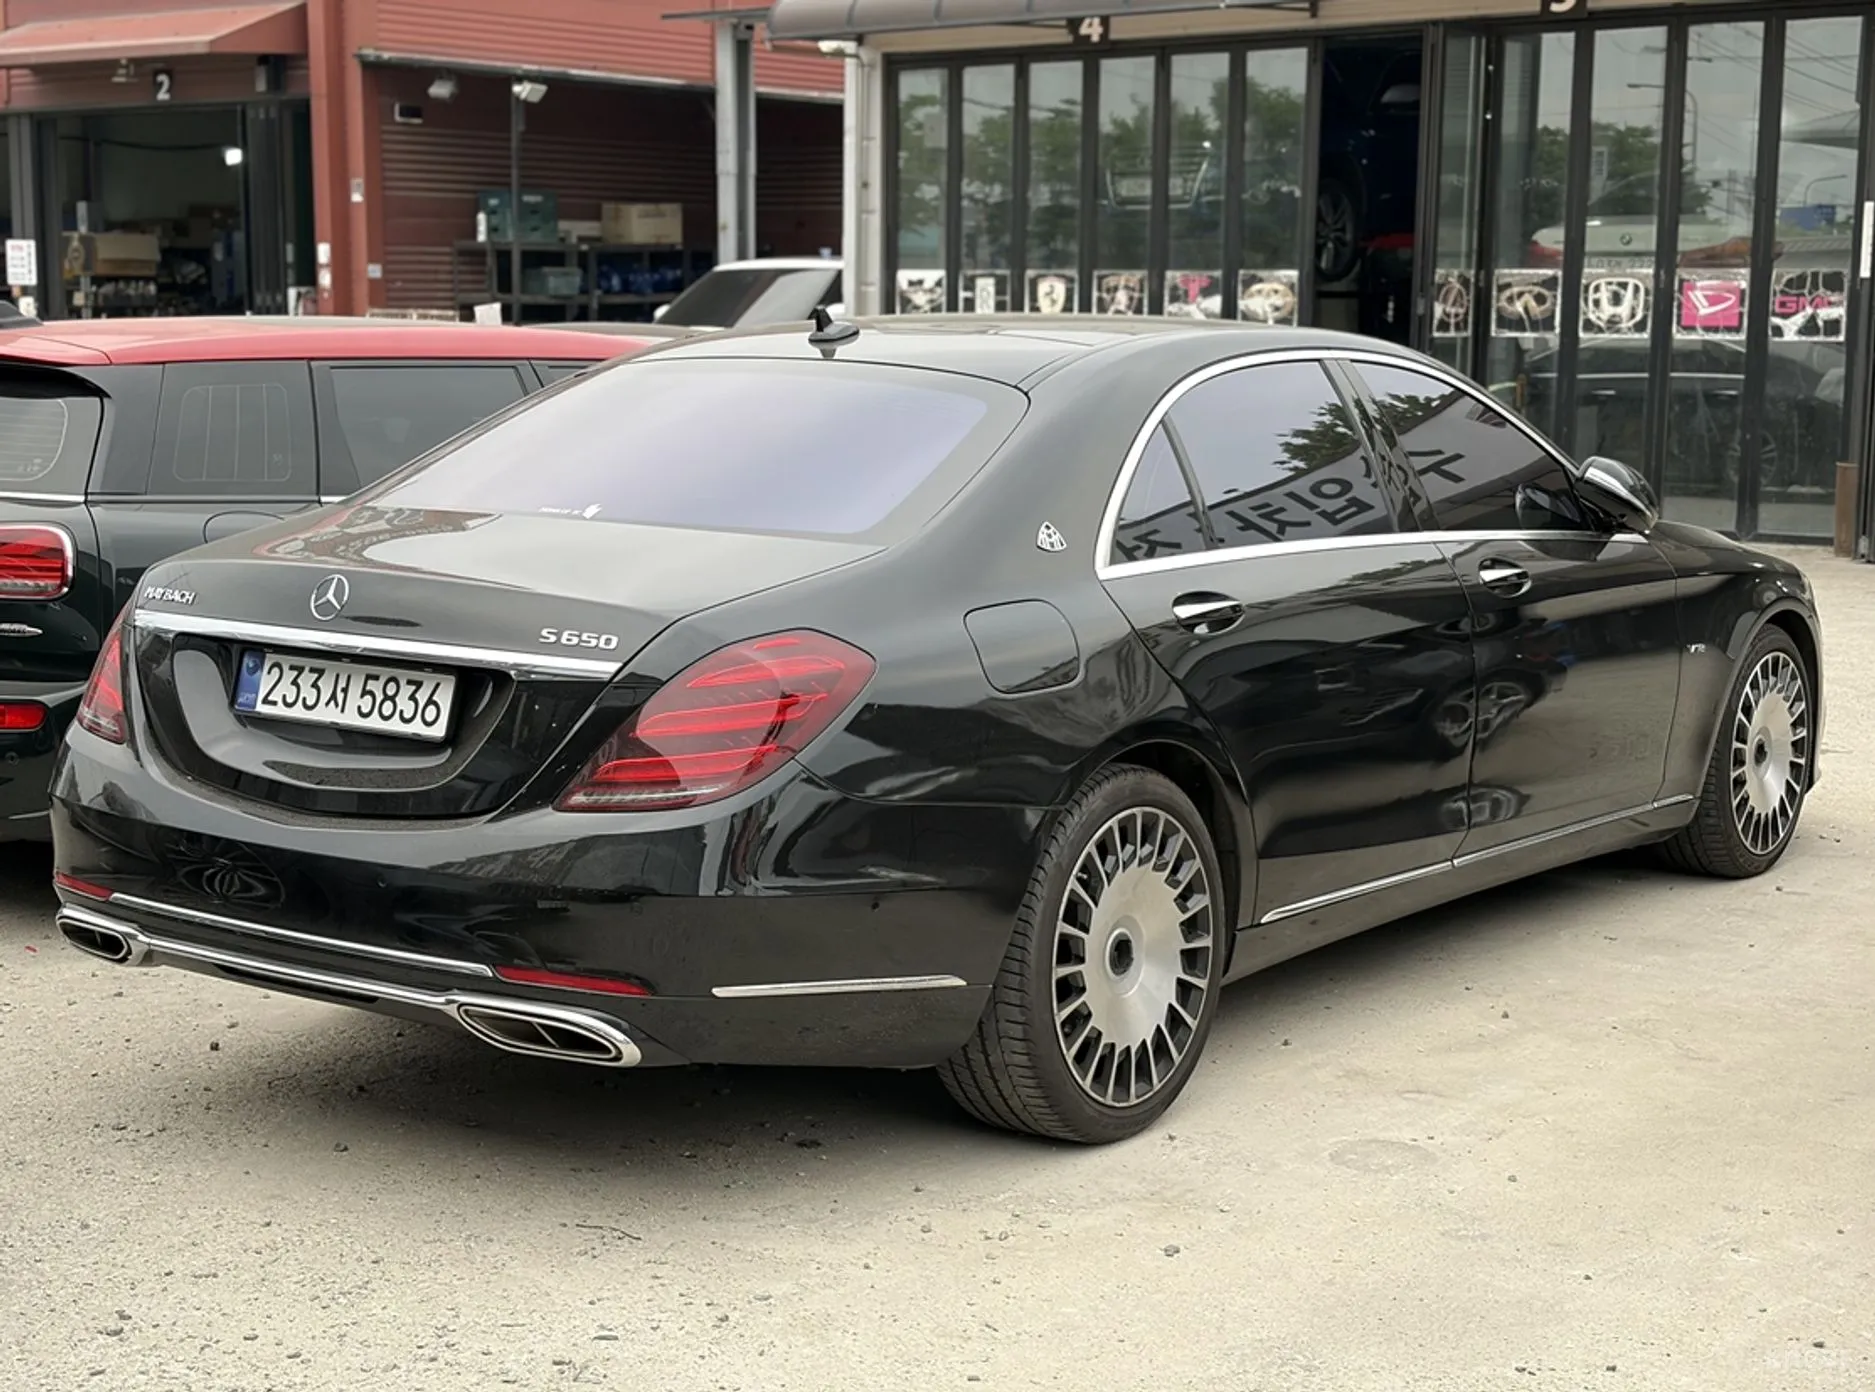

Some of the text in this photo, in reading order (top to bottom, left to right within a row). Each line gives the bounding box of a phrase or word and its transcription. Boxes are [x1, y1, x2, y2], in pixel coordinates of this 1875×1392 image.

[1079, 17, 1104, 43] 4
[156, 74, 171, 101] 2
[144, 586, 196, 605] MAYBACH
[538, 627, 619, 650] S 650
[261, 661, 442, 727] 233서 5836
